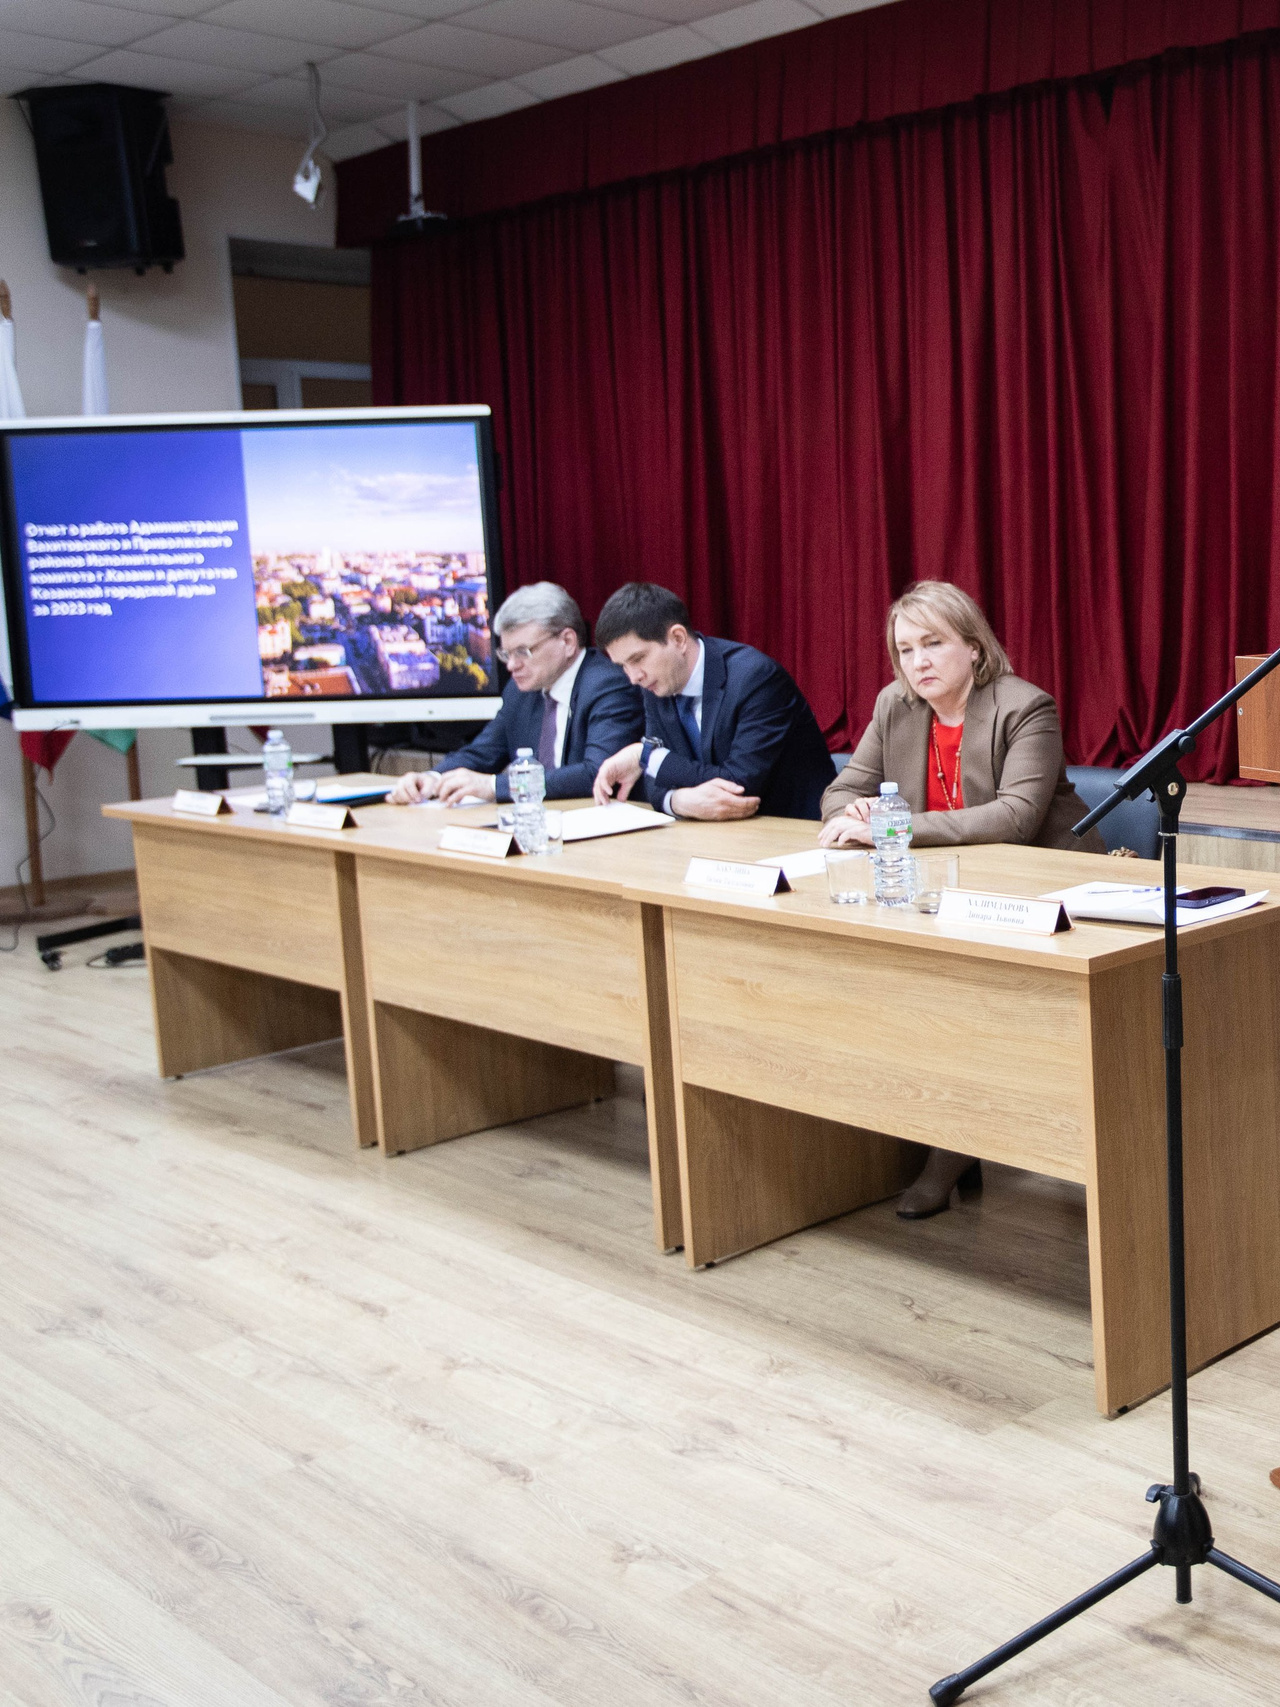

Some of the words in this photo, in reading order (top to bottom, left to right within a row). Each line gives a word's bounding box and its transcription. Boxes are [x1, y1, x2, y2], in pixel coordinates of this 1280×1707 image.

[24, 522, 68, 537] Отчет
[67, 523, 80, 537] о
[79, 520, 129, 538] работе
[129, 519, 239, 536] Администрации
[121, 538, 132, 551] и
[131, 535, 233, 552] Приволжского
[85, 552, 205, 568] Исполнительного
[155, 569, 166, 582] и
[30, 584, 103, 600] Казанской
[103, 582, 176, 599] городской
[32, 604, 50, 617] за
[50, 600, 87, 617] 2023
[87, 602, 113, 617] год
